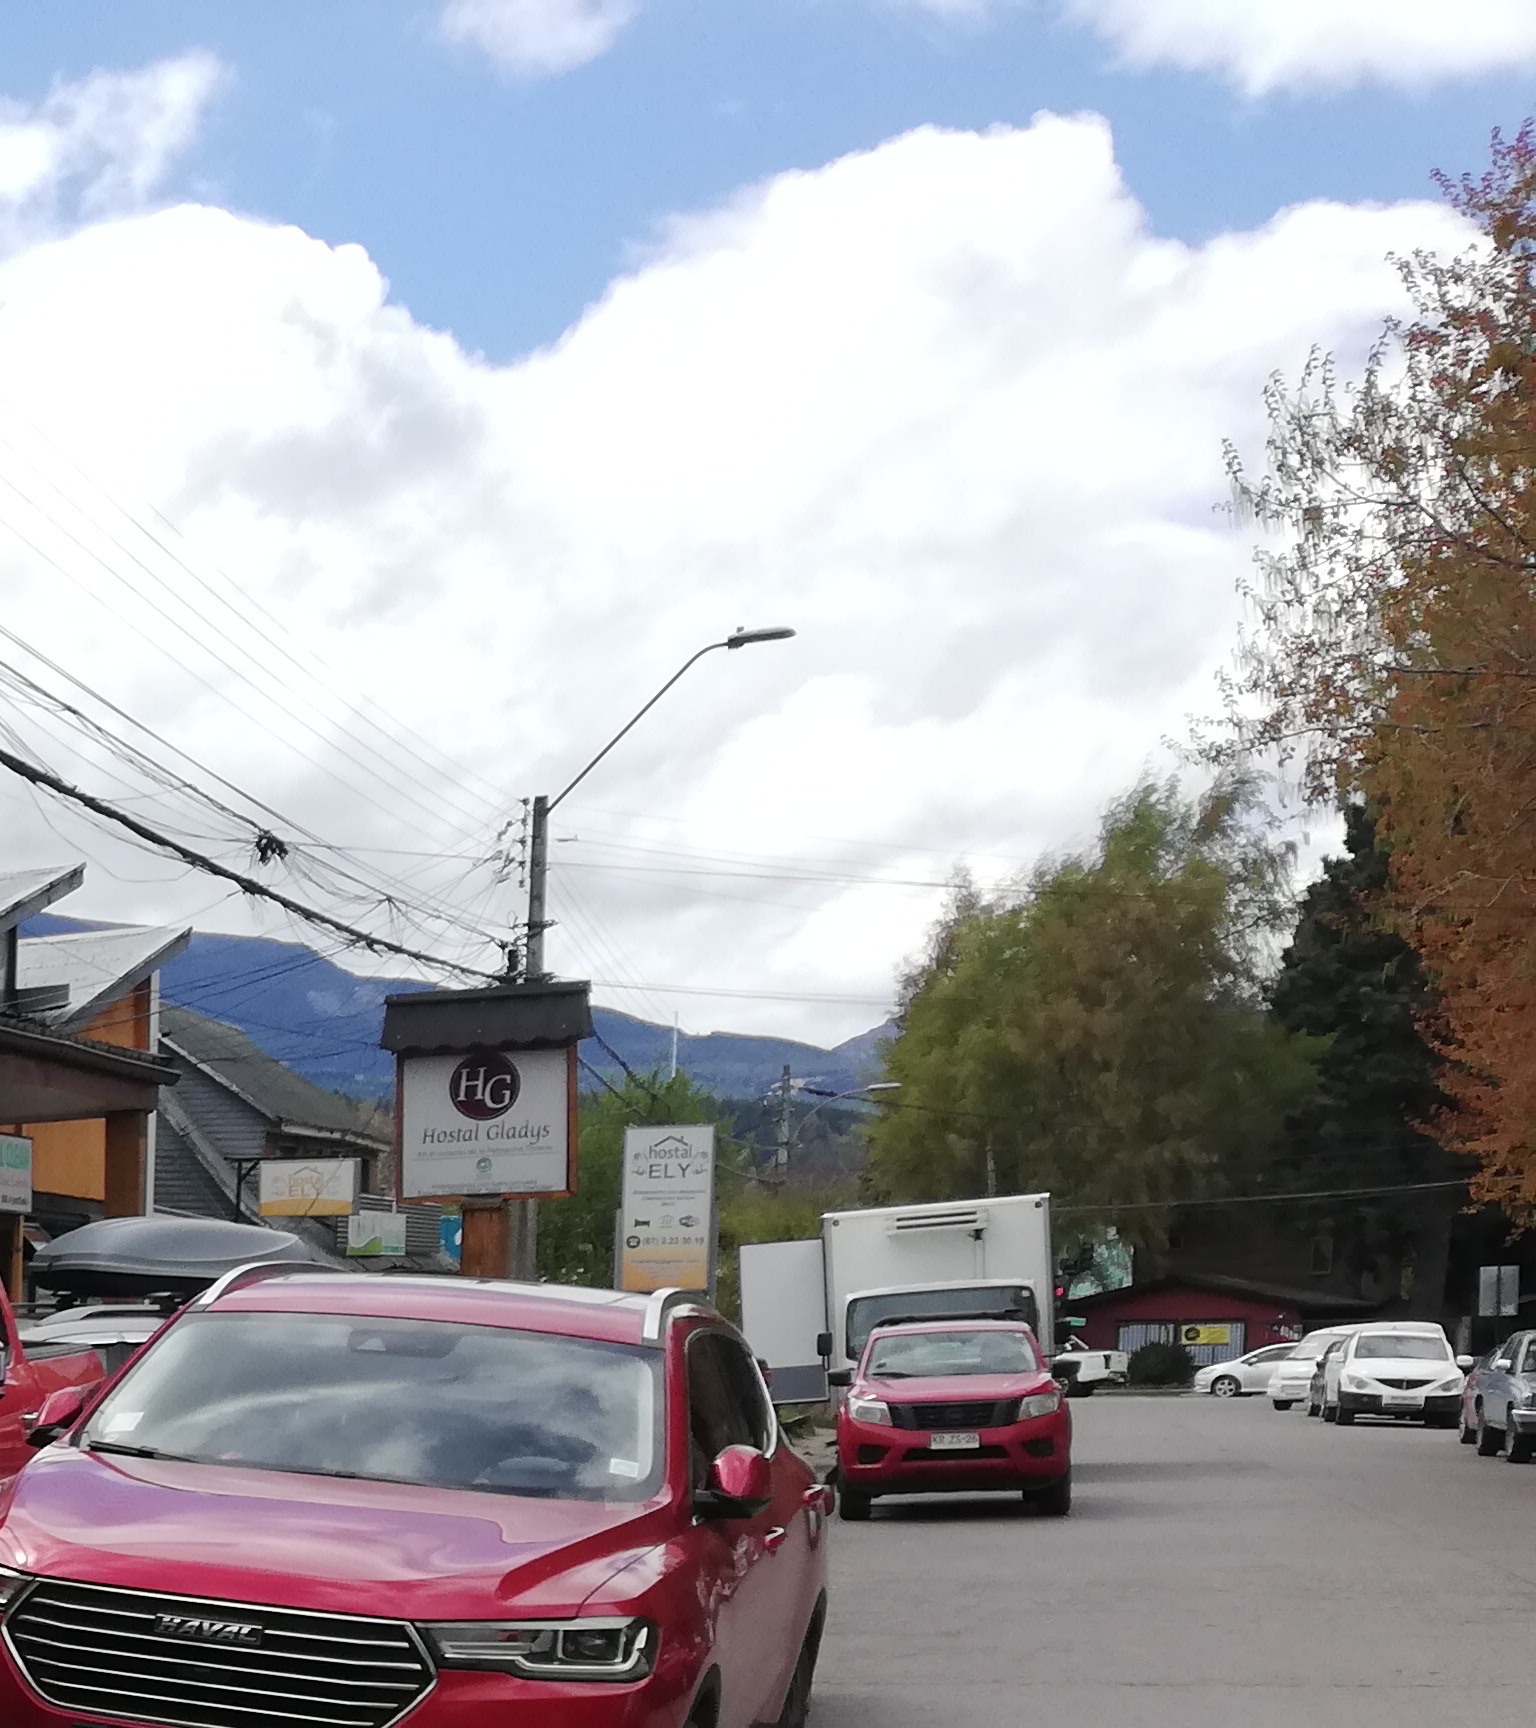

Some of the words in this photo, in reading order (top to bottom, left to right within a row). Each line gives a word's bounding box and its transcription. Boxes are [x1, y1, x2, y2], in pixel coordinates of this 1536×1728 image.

[456, 1066, 512, 1110] HG
[422, 1123, 479, 1145] Hostal
[486, 1119, 551, 1146] Gladys
[648, 1144, 693, 1160] hostal
[648, 1163, 692, 1179] ELY
[158, 1615, 258, 1642] HAVAL
